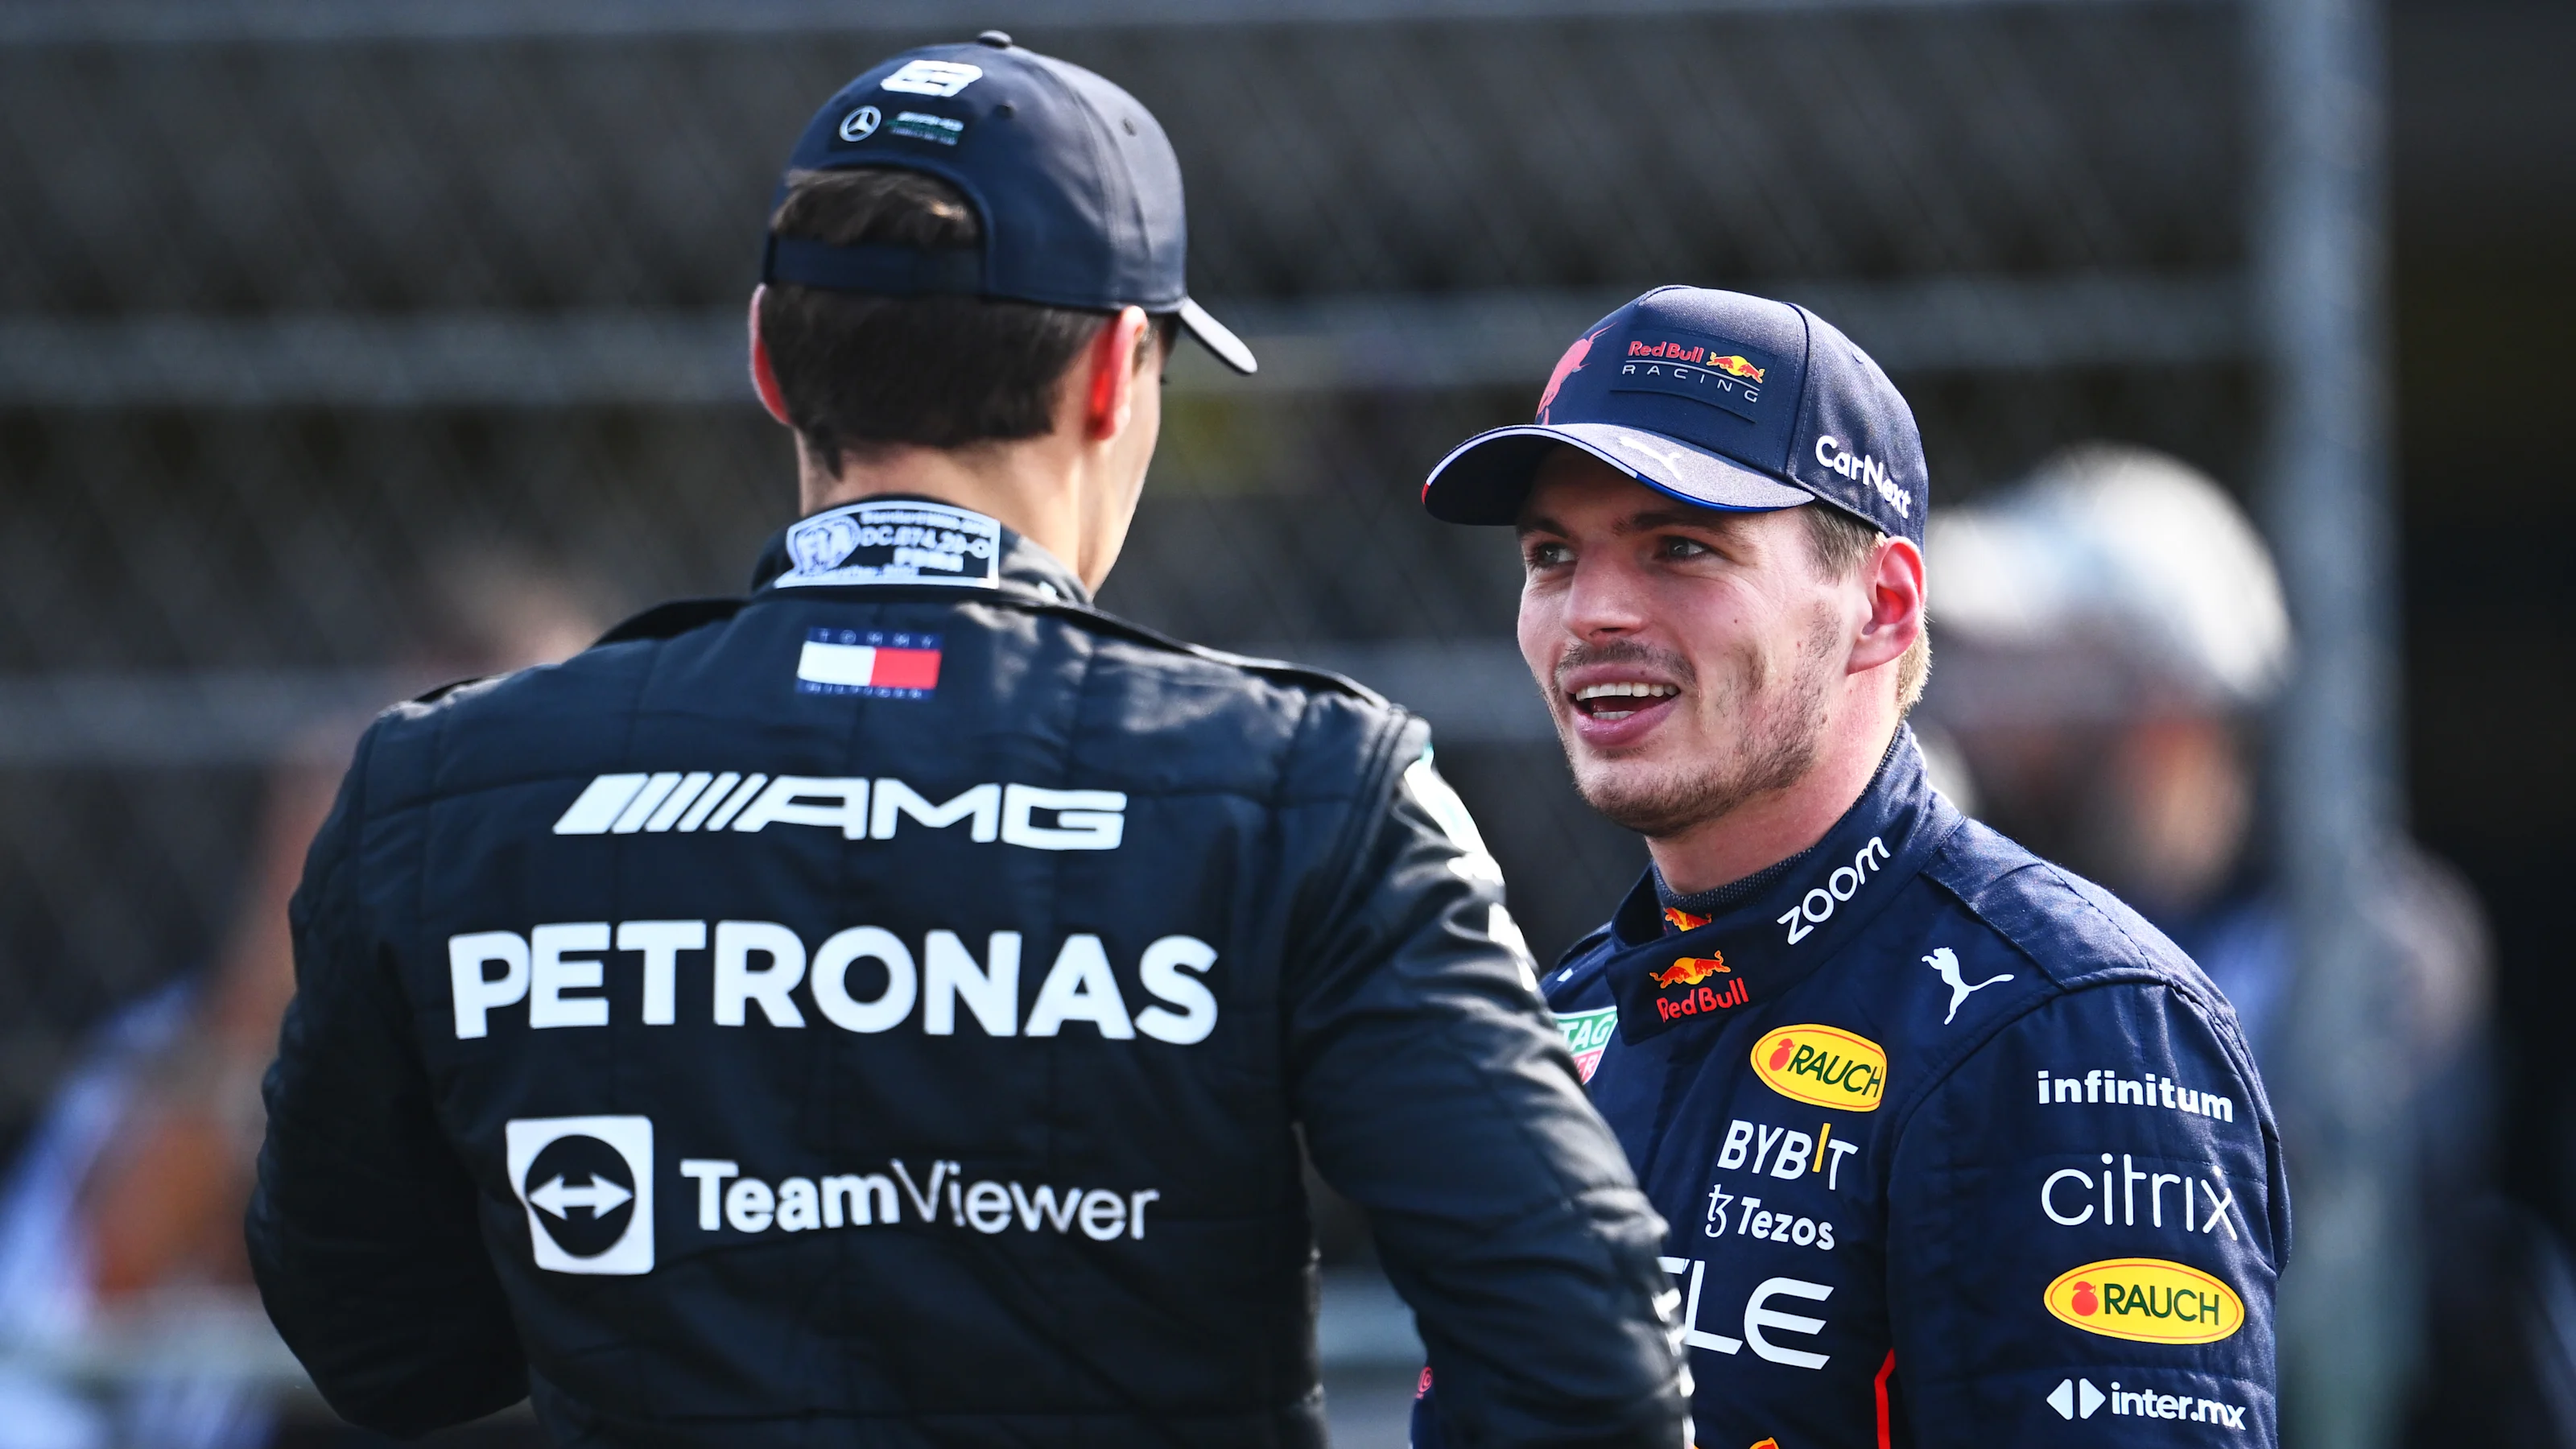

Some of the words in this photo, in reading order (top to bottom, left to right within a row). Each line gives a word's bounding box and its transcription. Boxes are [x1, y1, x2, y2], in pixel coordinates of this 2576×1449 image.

[1628, 341, 1666, 357] Red
[1666, 343, 1704, 363] Bull
[1621, 365, 1759, 403] RACING
[1814, 435, 1912, 520] CarNext
[733, 775, 1128, 851] AMG
[1777, 836, 1891, 945] zoom
[448, 920, 1218, 1045] PETRONAS
[1656, 989, 1698, 1023] Red
[1698, 977, 1749, 1013] Bull
[1557, 1013, 1616, 1051] TAG
[1788, 1043, 1884, 1098] RAUCH
[2037, 1069, 2234, 1124] infinitum
[1716, 1119, 1859, 1191] BYBIT
[679, 1158, 1161, 1241] TeamViewer
[1737, 1195, 1835, 1251] Tezos
[2041, 1152, 2239, 1242] citrix
[2104, 1282, 2220, 1327] RAUCH
[2111, 1381, 2247, 1431] inter.mx
